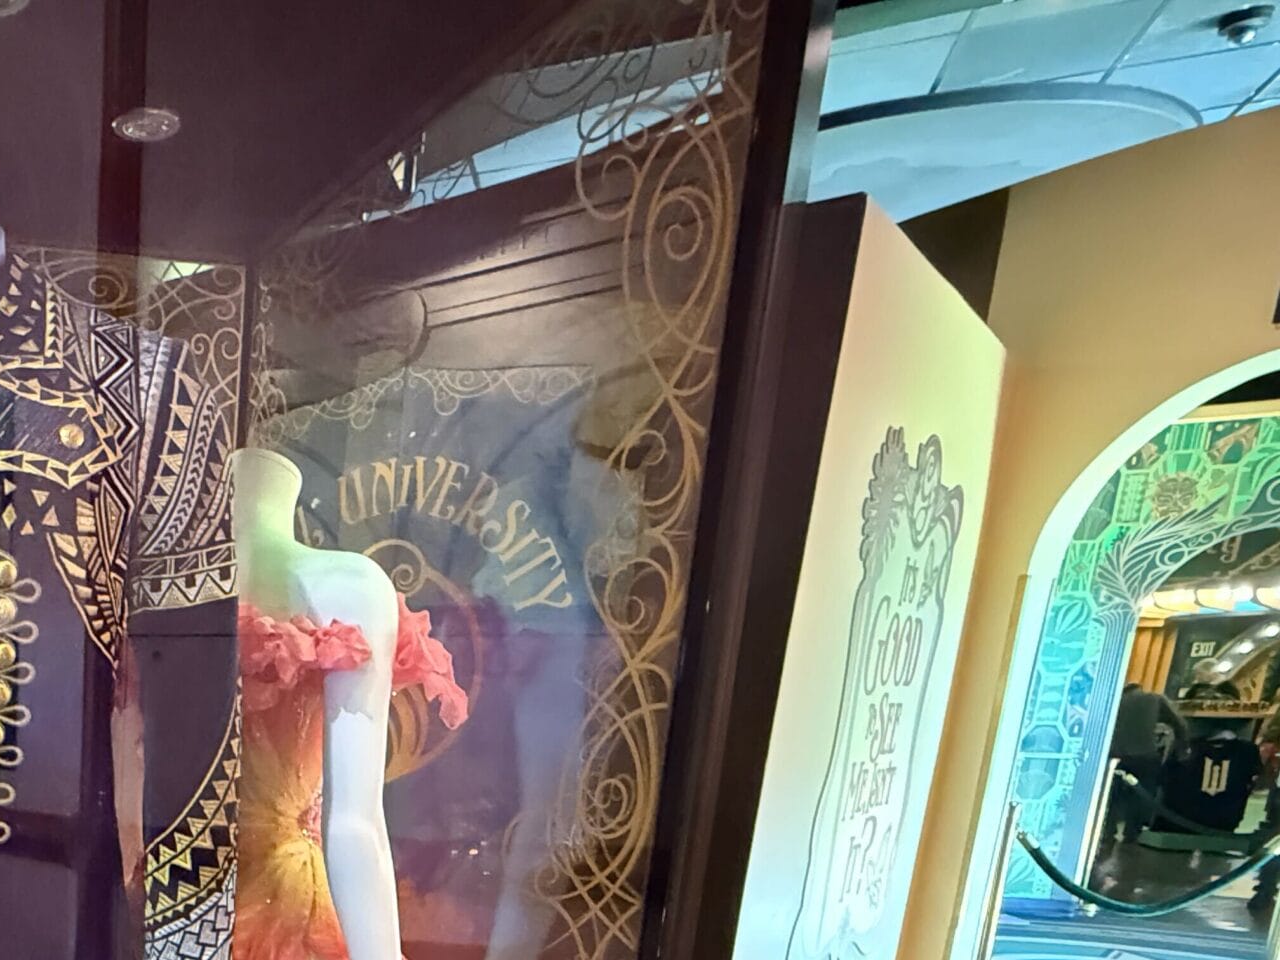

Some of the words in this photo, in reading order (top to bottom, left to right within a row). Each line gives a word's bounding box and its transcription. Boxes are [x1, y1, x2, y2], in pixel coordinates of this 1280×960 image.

[338, 456, 574, 612] UNIVERSITY
[864, 595, 923, 696] GOOD
[1190, 641, 1216, 657] EXIT
